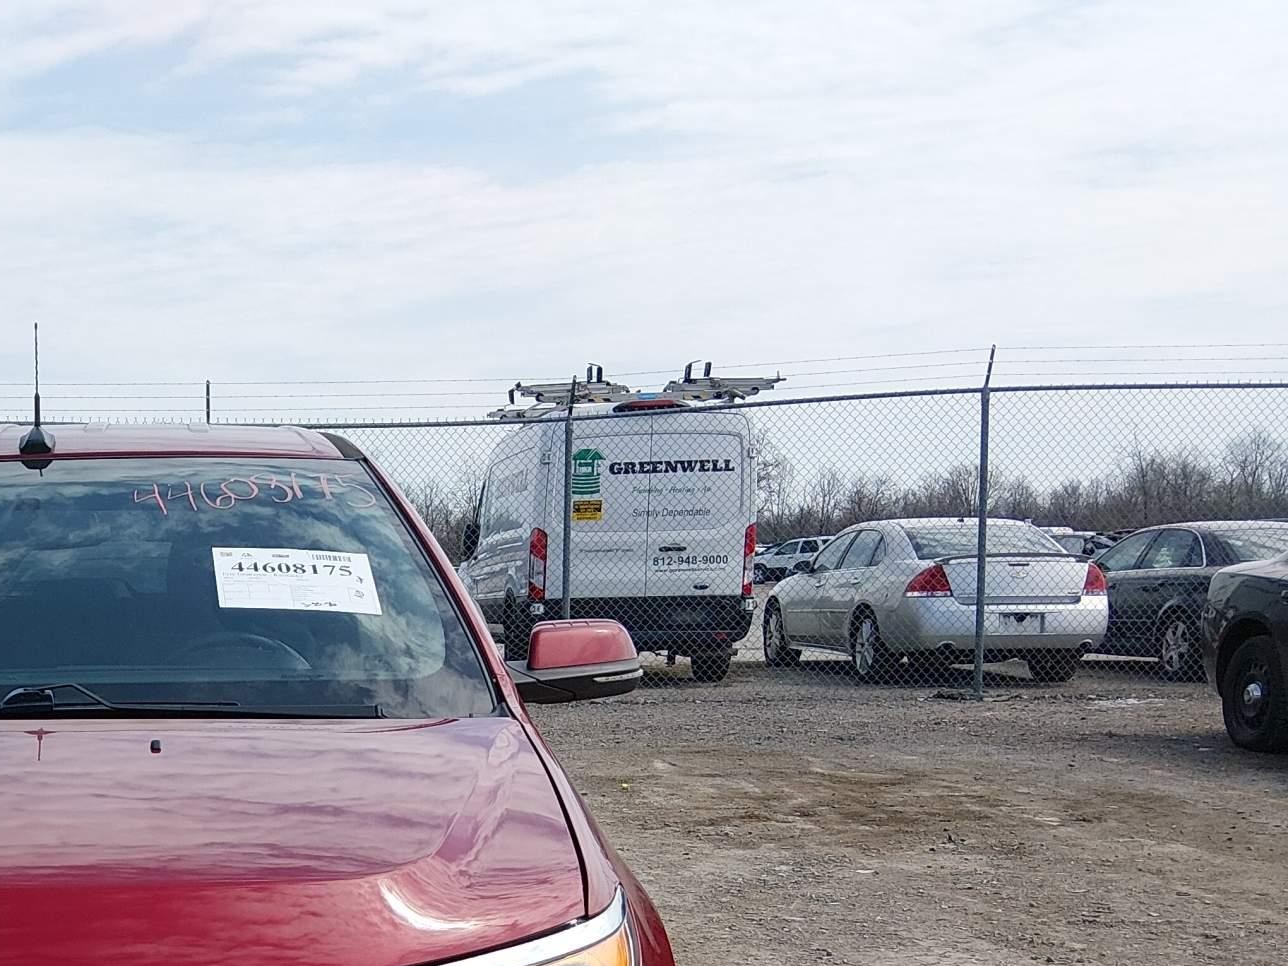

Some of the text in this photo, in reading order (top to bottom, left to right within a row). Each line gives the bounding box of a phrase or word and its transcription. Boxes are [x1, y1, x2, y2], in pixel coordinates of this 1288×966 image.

[609, 459, 735, 475] GREENWELL
[661, 506, 711, 519] Dependable
[652, 554, 729, 567] 812-948-9000
[231, 560, 353, 577] 44608175
